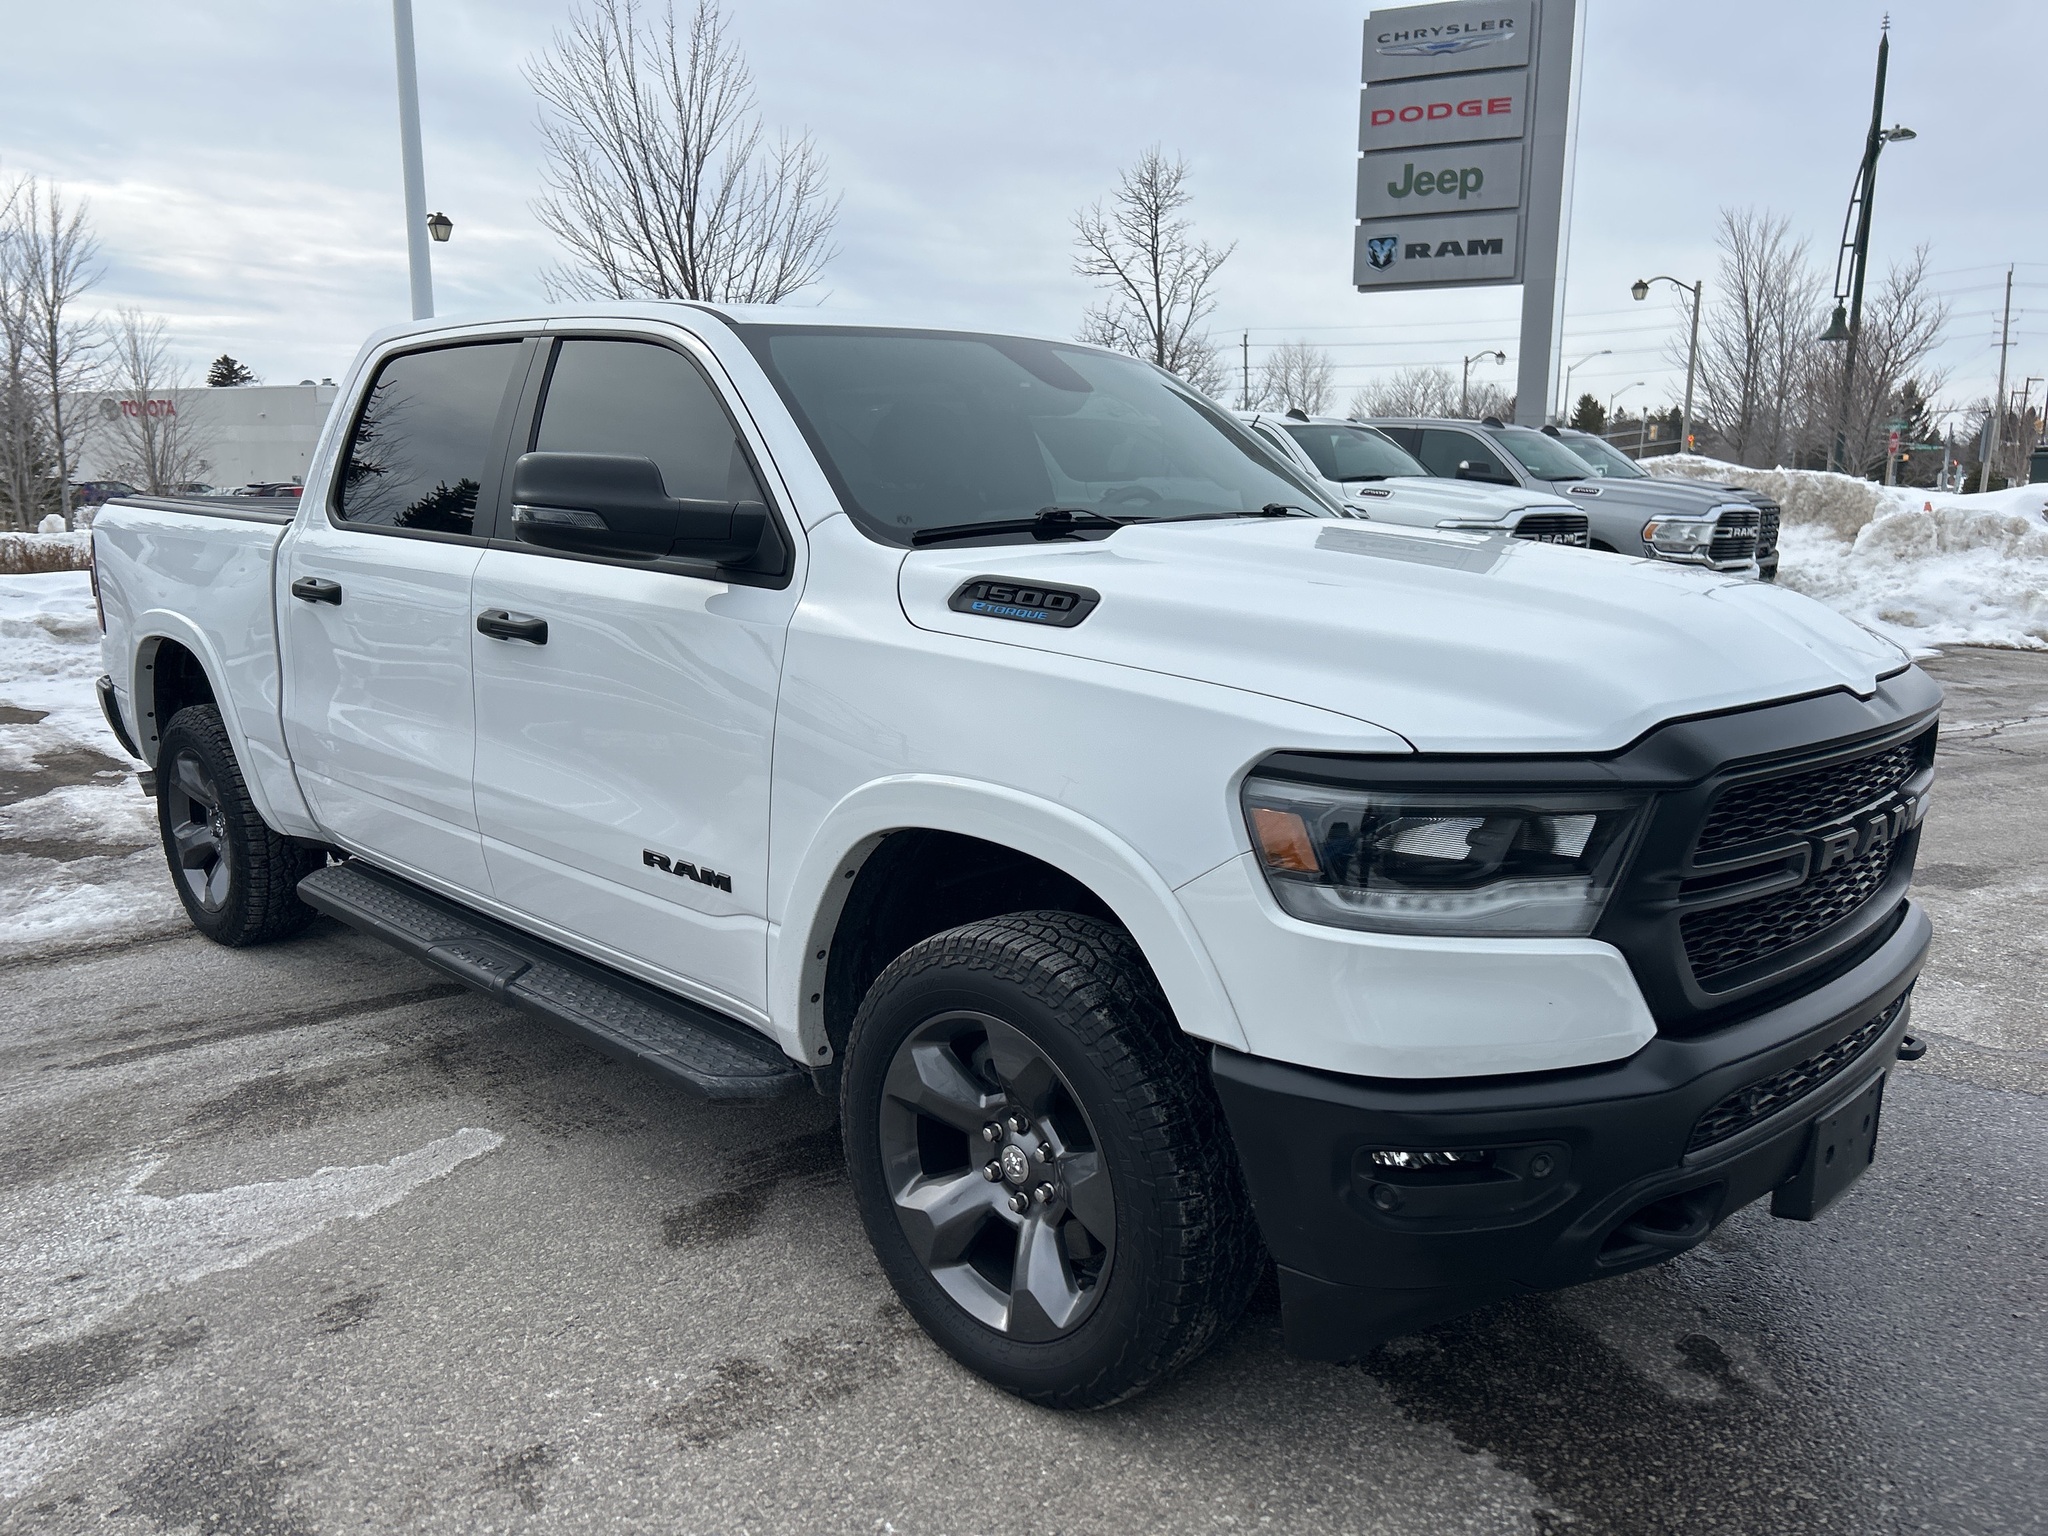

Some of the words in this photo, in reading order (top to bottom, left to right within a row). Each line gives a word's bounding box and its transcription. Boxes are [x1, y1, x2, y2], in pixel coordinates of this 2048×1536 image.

[1377, 18, 1514, 43] CHRYSLER
[1371, 97, 1512, 127] DODGE
[1387, 163, 1484, 200] Jeep
[1405, 238, 1503, 259] RAM
[976, 584, 1074, 610] 1500
[1820, 796, 1917, 872] RAM
[642, 848, 732, 894] RAM
